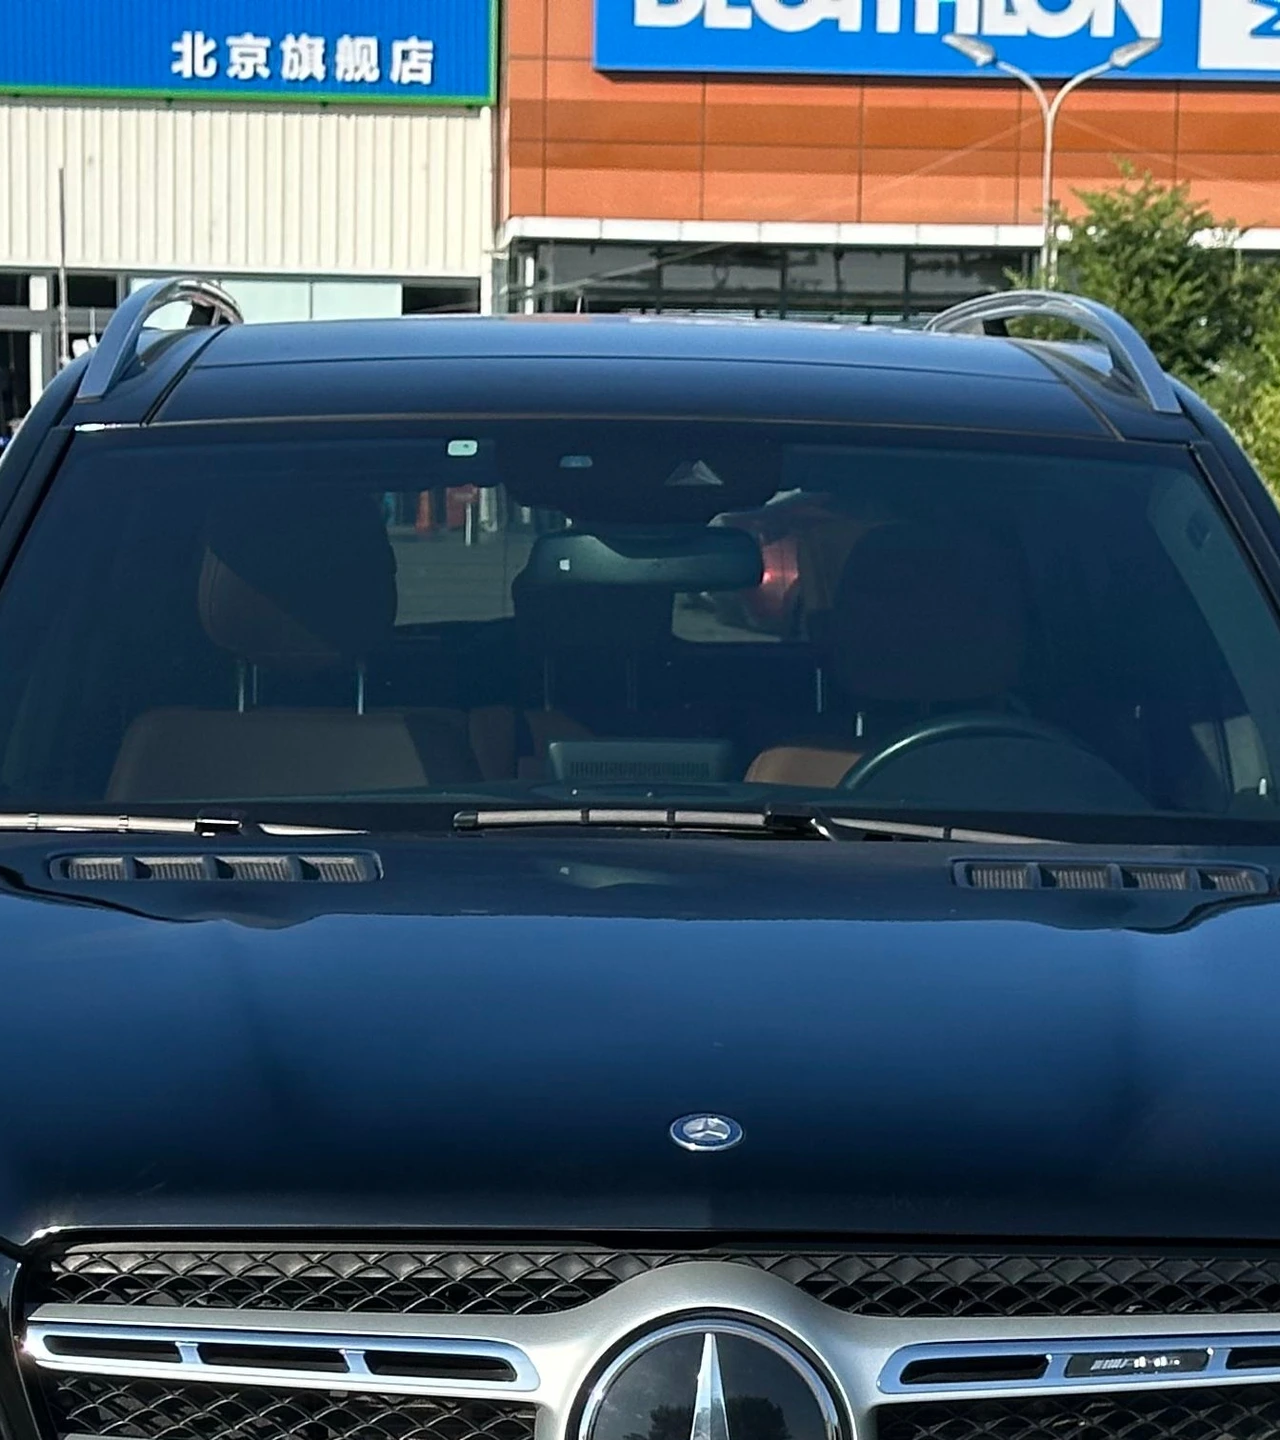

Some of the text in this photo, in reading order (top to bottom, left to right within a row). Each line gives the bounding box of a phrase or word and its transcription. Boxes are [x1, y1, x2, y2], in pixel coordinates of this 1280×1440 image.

[171, 31, 434, 85] 北京旗舰店
